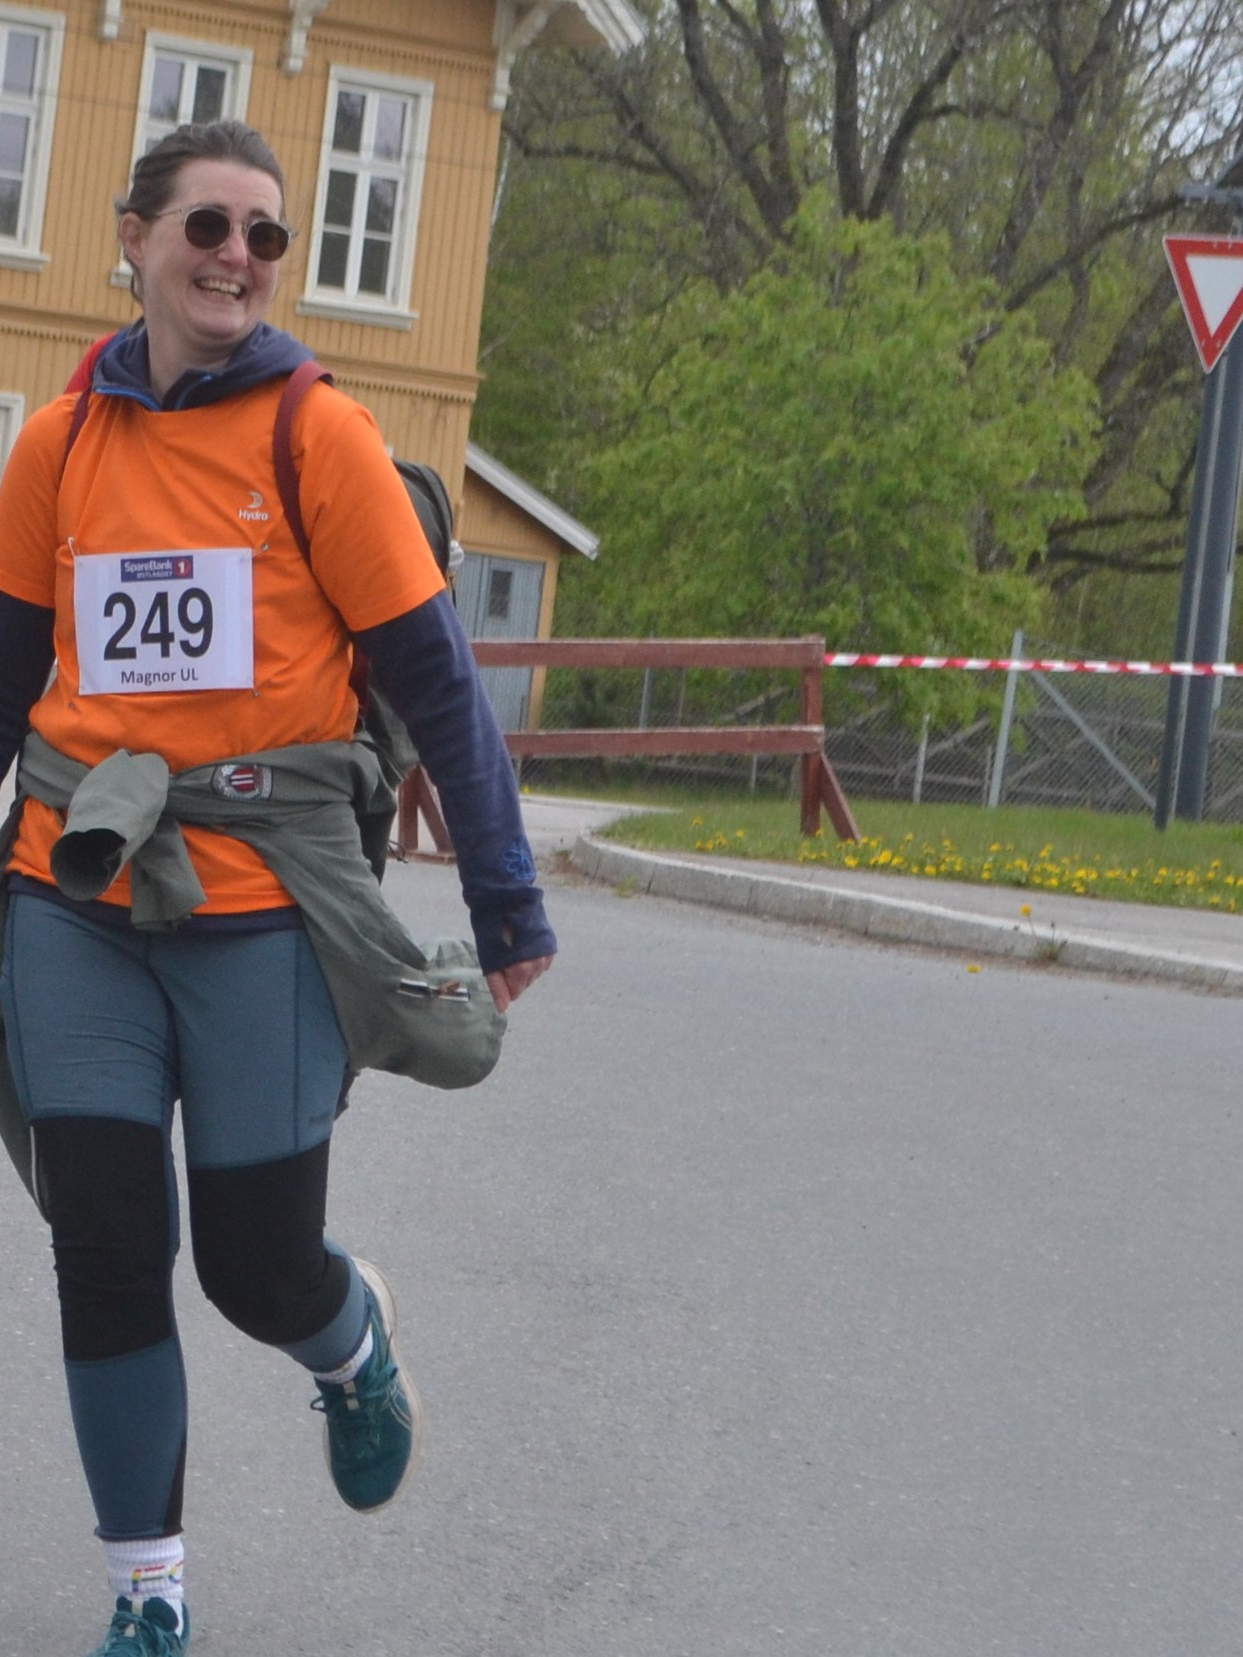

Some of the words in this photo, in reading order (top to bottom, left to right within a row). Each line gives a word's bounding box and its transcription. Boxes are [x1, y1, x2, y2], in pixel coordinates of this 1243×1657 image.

[239, 508, 269, 521] Hydro
[124, 560, 173, 573] SpareBank
[177, 561, 186, 574] 1
[103, 587, 213, 661] 249
[121, 670, 177, 687] Magnor
[180, 667, 199, 682] UL
